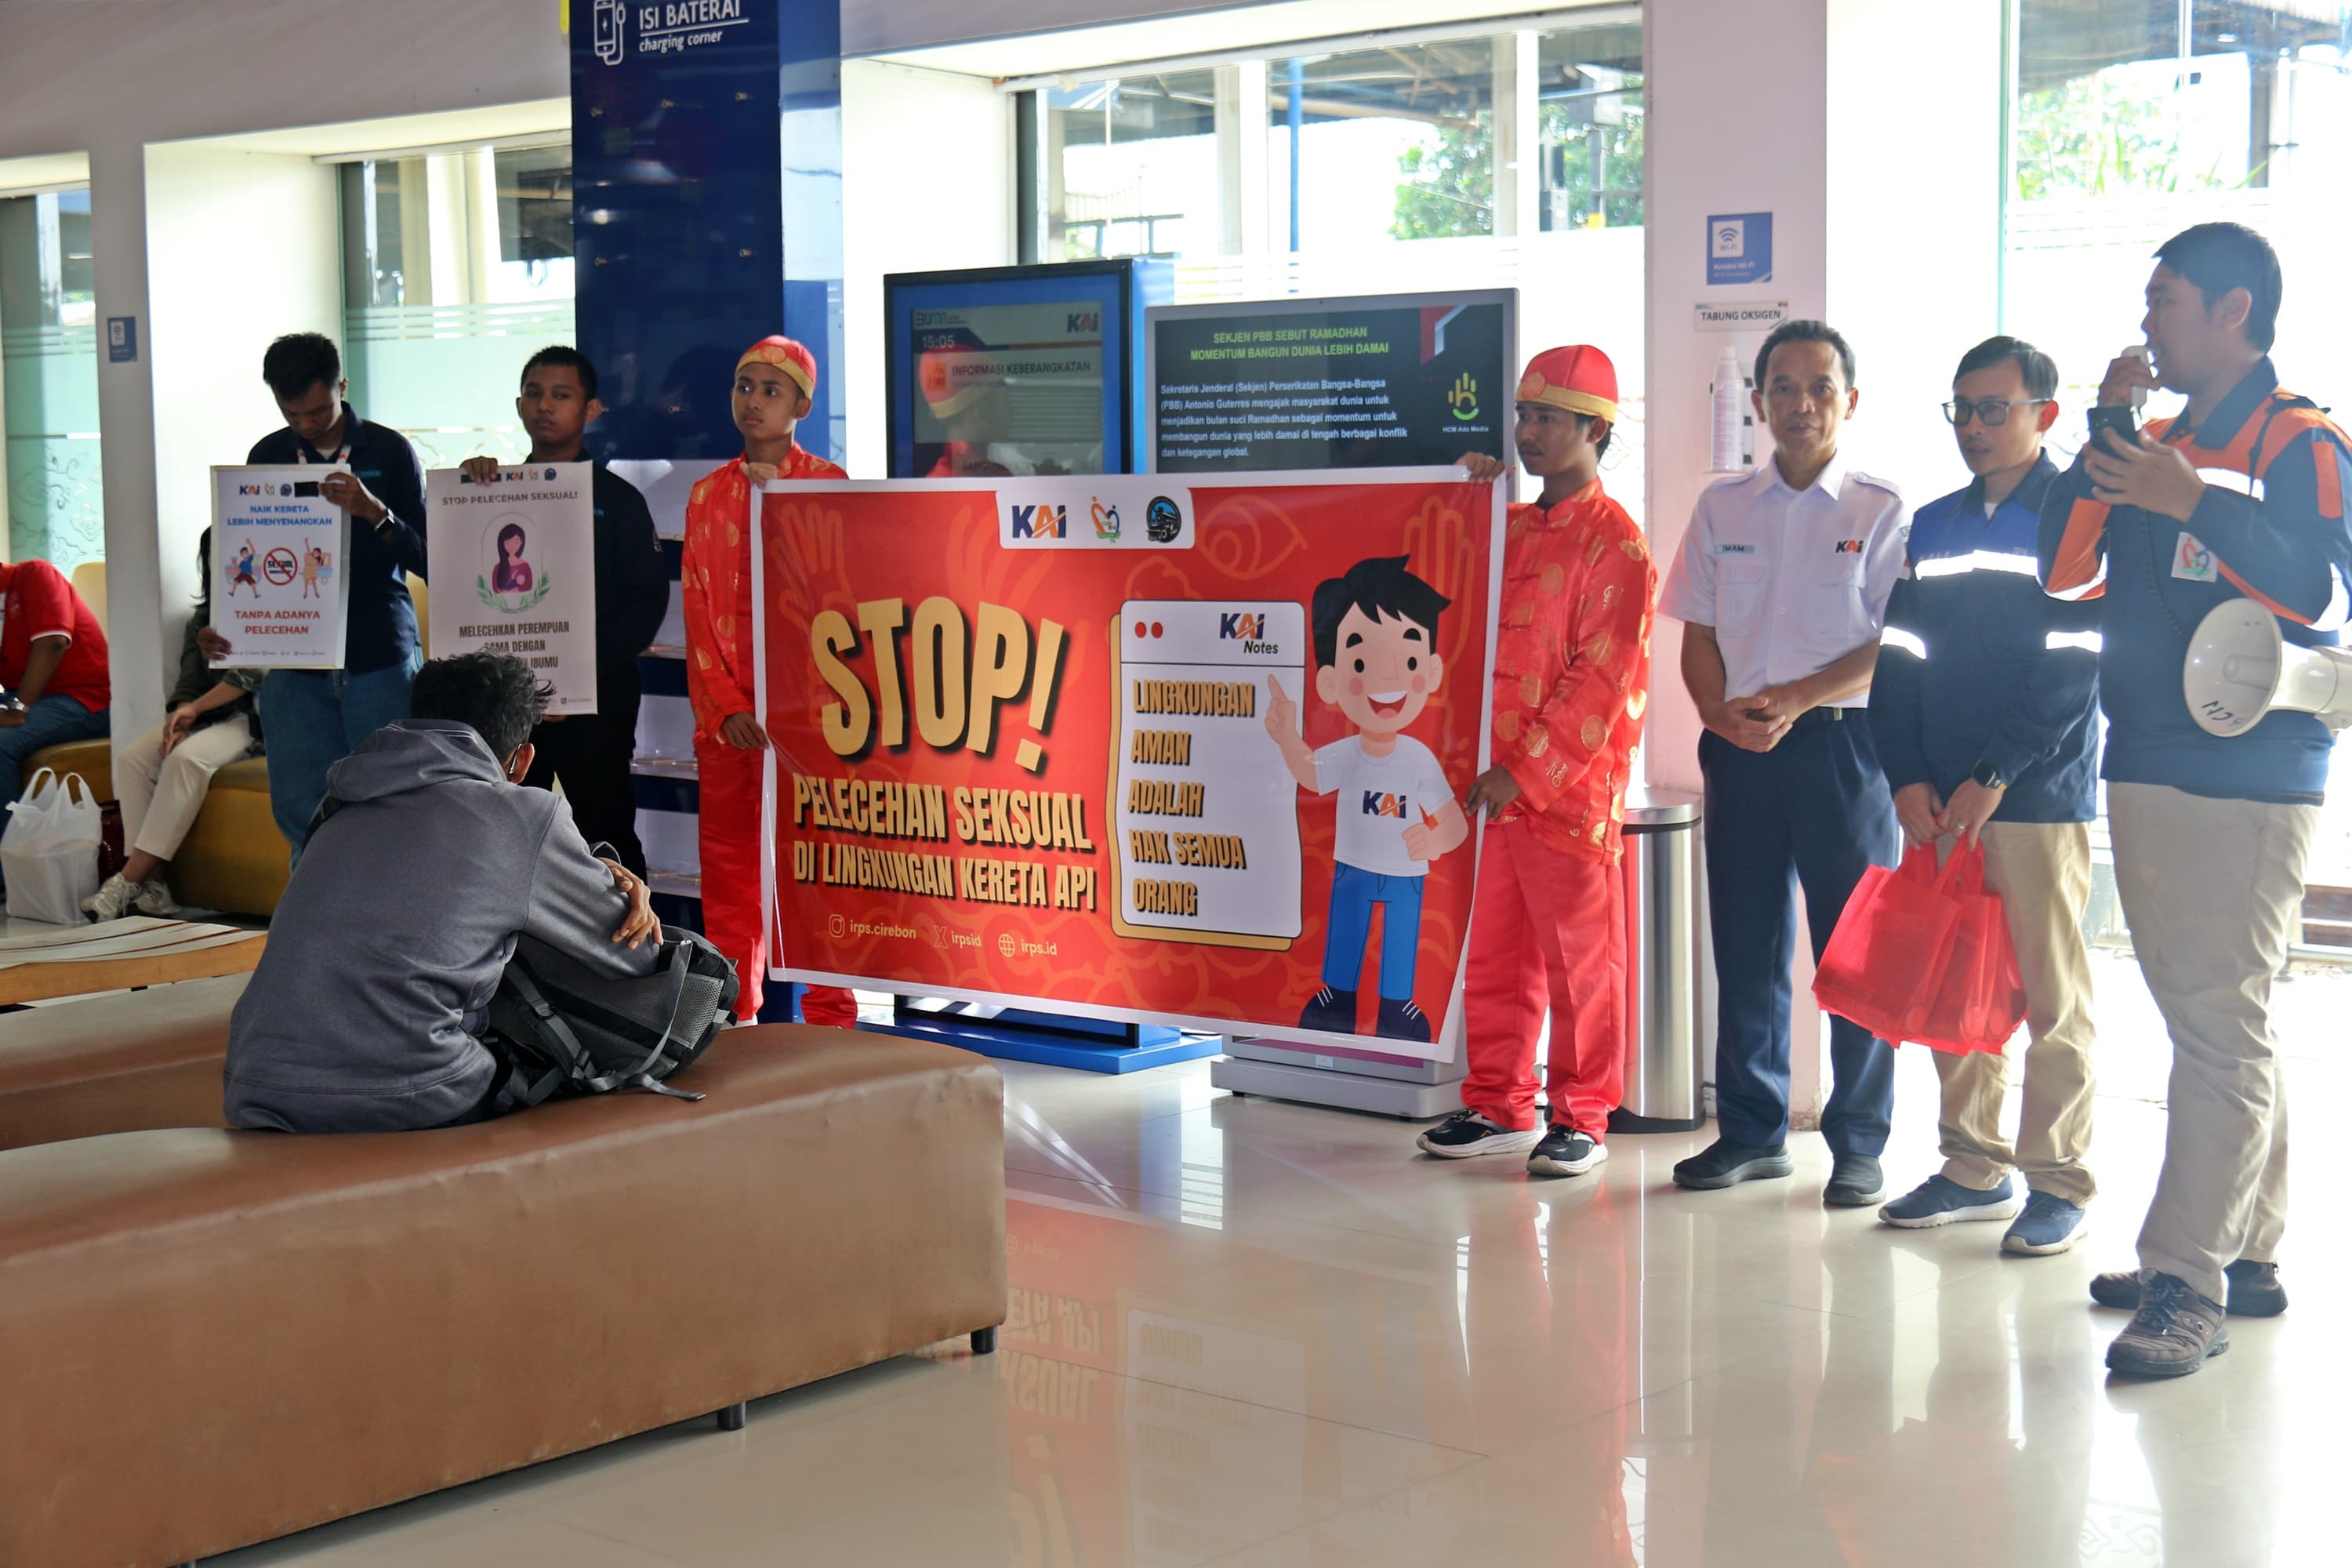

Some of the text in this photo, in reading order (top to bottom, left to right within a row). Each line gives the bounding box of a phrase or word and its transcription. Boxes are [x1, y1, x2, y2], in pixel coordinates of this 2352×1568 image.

[639, 0, 740, 31] ISI BATERAI
[639, 31, 722, 53] charging corner
[1701, 310, 1780, 321] TABUNG OKSIGEN
[921, 334, 954, 350] 15:05
[1214, 327, 1367, 344] SEKJEN PBB SEBUT RAMADHAN
[1190, 343, 1389, 361] MOMENTUM BANGUN DUNIA LEBIH DAMAI
[952, 361, 1091, 376] INFORMASI KEBERANGKATAN
[1161, 379, 1386, 395] Sekretaris Jenderal (Sekjen) Perserikatan Bangsa-Bangsa
[1161, 394, 1389, 412] (PBB) Antonio Guterres mengajak masyarakat dunia untuk
[1161, 411, 1397, 427] menjadikan bulan suci Ramadhan sebagai momentum untuk
[1161, 427, 1408, 444] membangun dunia yang lebih damai di tengah berbagai konflik
[1161, 446, 1249, 459] dan ketegangan global.
[239, 485, 260, 496] KAI
[442, 491, 578, 506] STOP PELECEHAN SEKSUAL!
[250, 505, 310, 514] NAIK KERETA
[227, 517, 332, 526] LEBIH MENYENANGKAN
[1011, 504, 1066, 539] KAI
[1835, 539, 1864, 554] KAI
[234, 610, 321, 619] TANPA ADANYA
[245, 625, 309, 635] PELECEHAN
[459, 620, 570, 639] MELECEHKAN PEREMPUAN
[1219, 612, 1265, 640] KAI
[512, 639, 546, 652] DENGAN
[1243, 640, 1279, 655] Notes
[530, 656, 558, 669] IBUMU
[811, 596, 1069, 775] STOP!
[1133, 679, 1255, 717] LINGKUNGAN
[1131, 729, 1191, 765] AMAN
[1127, 779, 1204, 818] ADALAH
[1362, 789, 1406, 819] KAI
[792, 772, 1094, 852] PELECEHAN SEKSUAL
[1128, 829, 1247, 869] HAK SEMUA
[793, 840, 1096, 911] DI LINGKUNGAN KERETA API
[1132, 877, 1198, 916] ORANG
[849, 919, 916, 940] irps.cirebon
[951, 931, 982, 949] irpsid
[1020, 938, 1058, 956] irps.id
